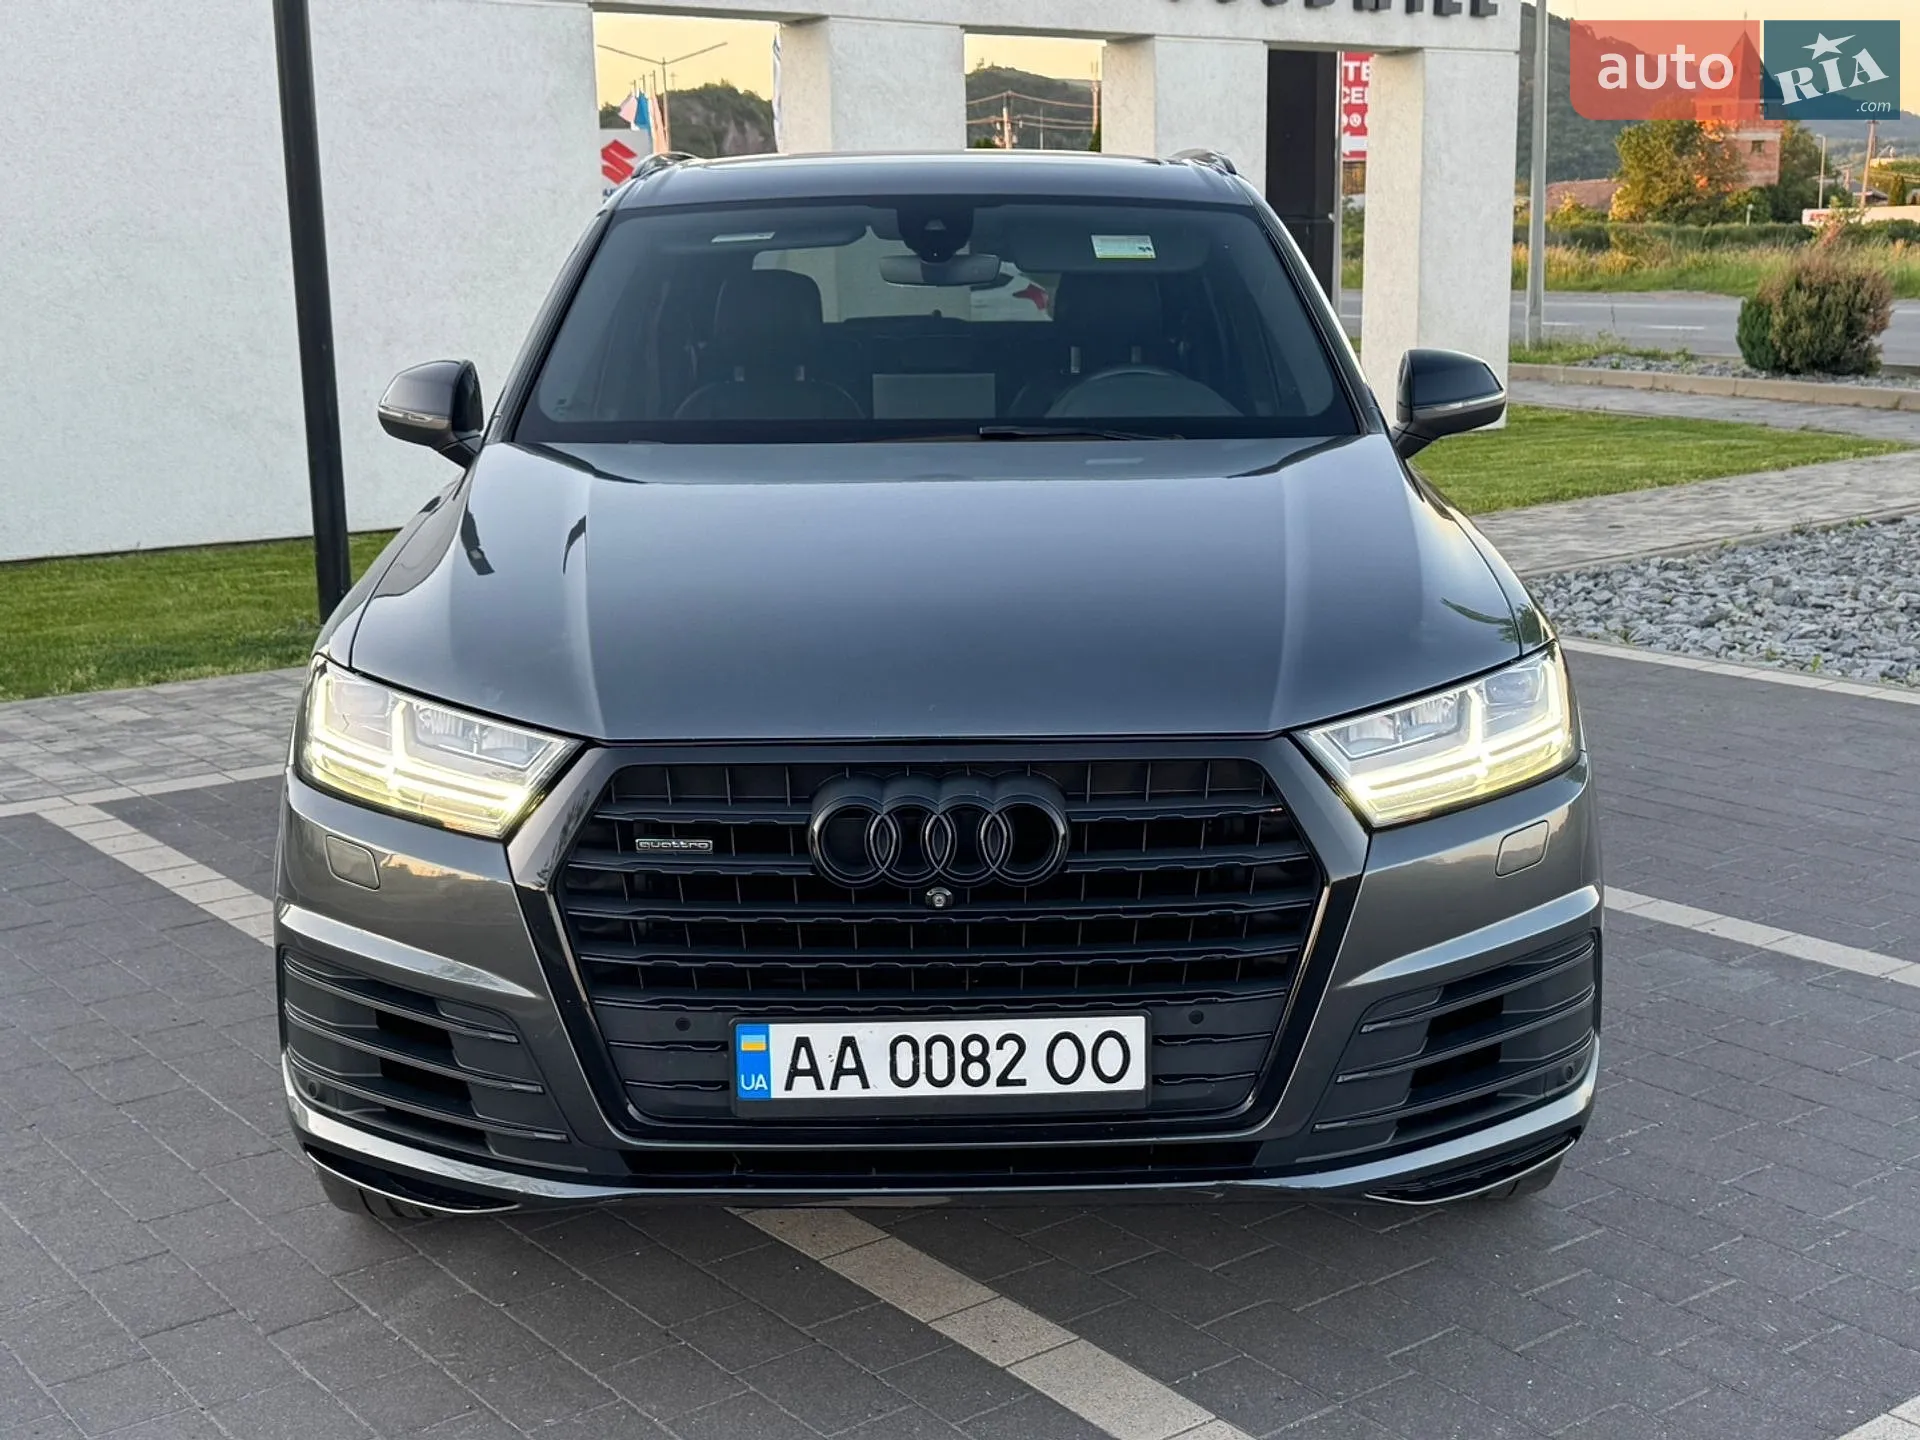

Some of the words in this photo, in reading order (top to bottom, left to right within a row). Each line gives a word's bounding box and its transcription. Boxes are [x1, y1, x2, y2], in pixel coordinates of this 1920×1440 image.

[640, 841, 708, 850] quattro
[784, 1036, 871, 1091] AA
[889, 1032, 1027, 1088] 0082
[740, 1074, 768, 1091] UA
